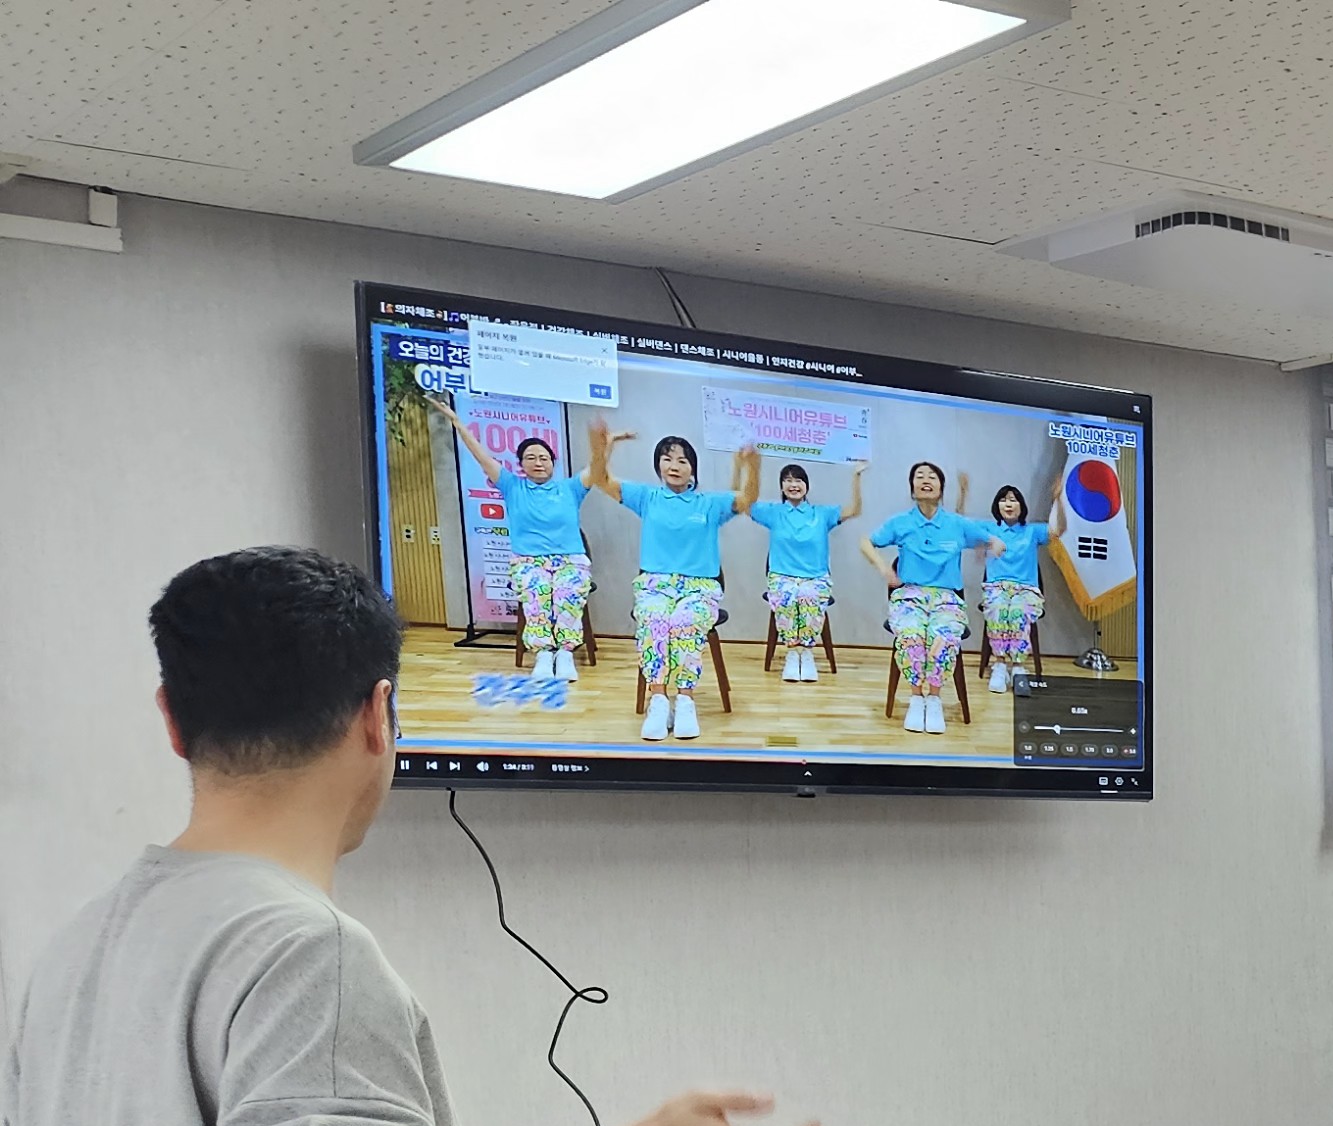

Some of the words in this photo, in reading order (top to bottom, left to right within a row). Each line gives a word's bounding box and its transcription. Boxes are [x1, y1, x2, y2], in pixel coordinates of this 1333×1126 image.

[398, 340, 444, 362] 오늘의
[637, 337, 673, 351] 실버댄스
[680, 344, 715, 357] 댄스체조
[473, 408, 545, 424] 노원시니어유튜브
[728, 400, 848, 430] 노원시니어유튜브
[1049, 422, 1136, 447] 노원시니어유튜브
[1066, 441, 1120, 459] 100세청춘
